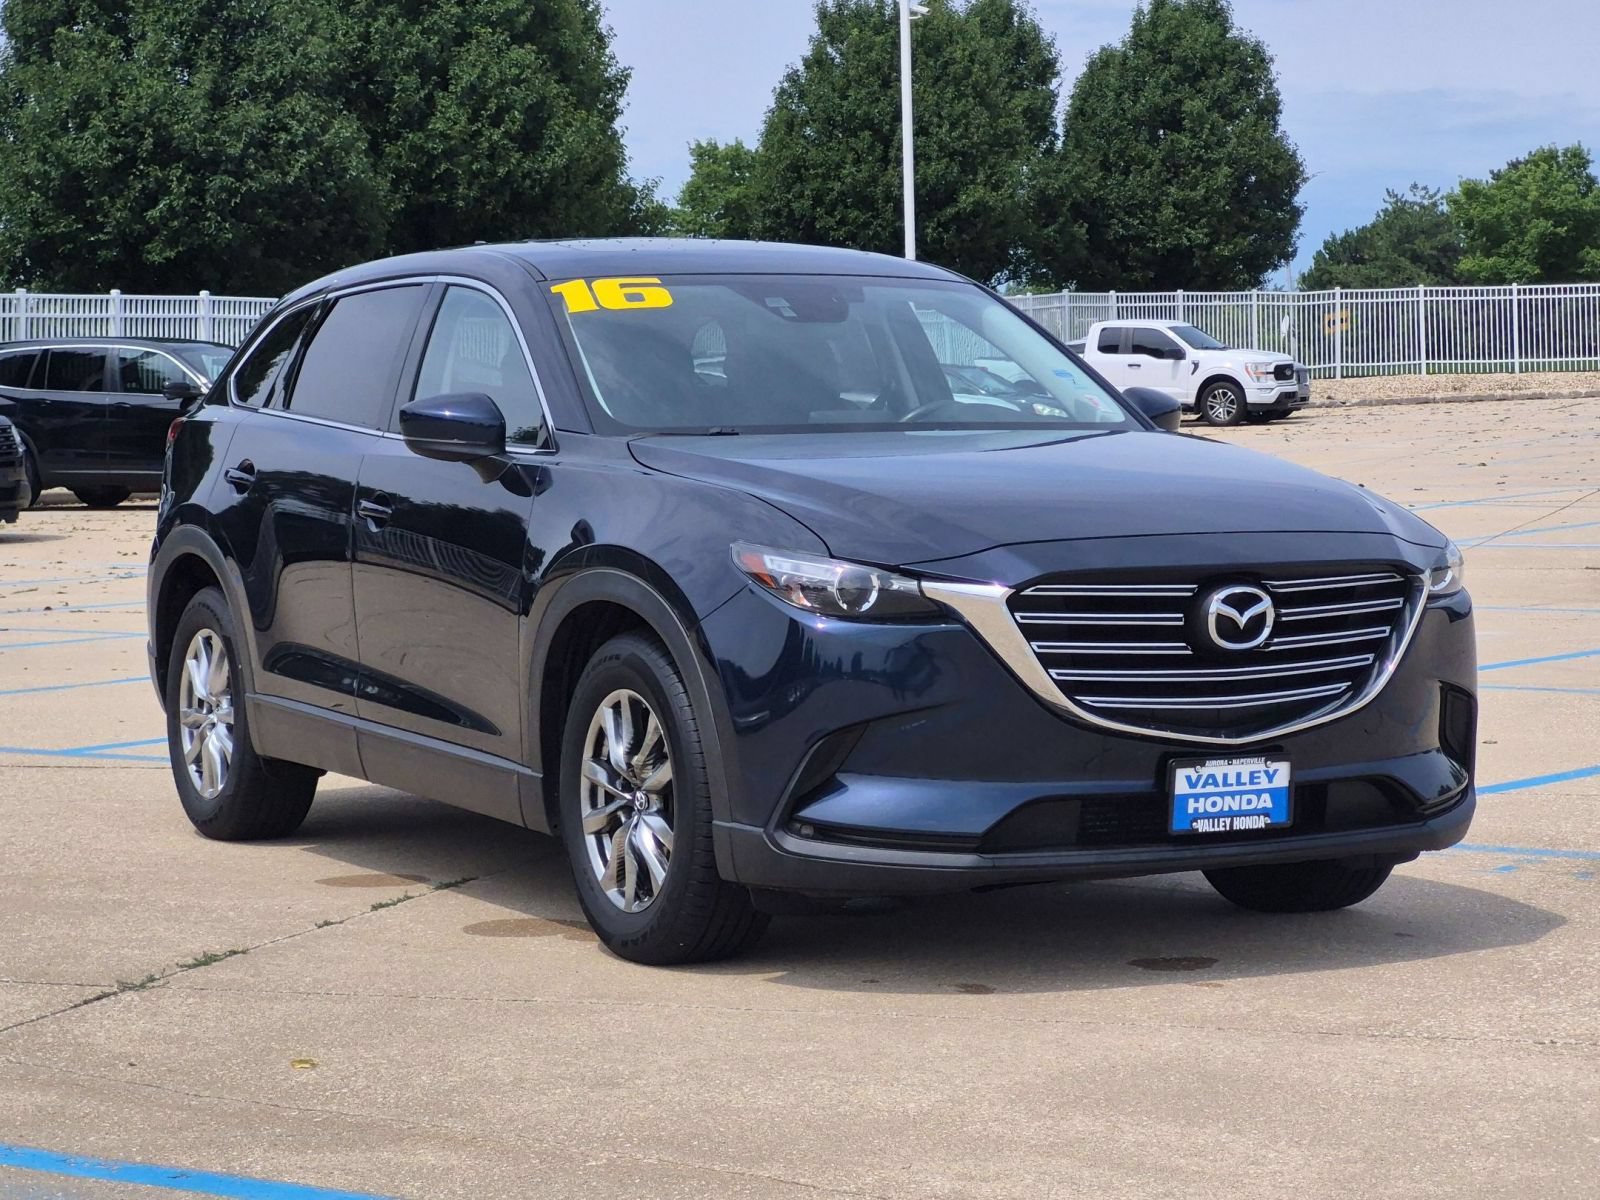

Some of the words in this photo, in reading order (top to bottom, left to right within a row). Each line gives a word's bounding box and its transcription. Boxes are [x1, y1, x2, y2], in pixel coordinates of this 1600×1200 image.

[550, 277, 673, 313] 16
[1232, 757, 1265, 765] NAPERVILLE
[1185, 769, 1279, 789] VALLEY
[1187, 793, 1272, 814] HONDA
[1197, 818, 1231, 832] VALLEY
[1233, 815, 1265, 830] HONDA
